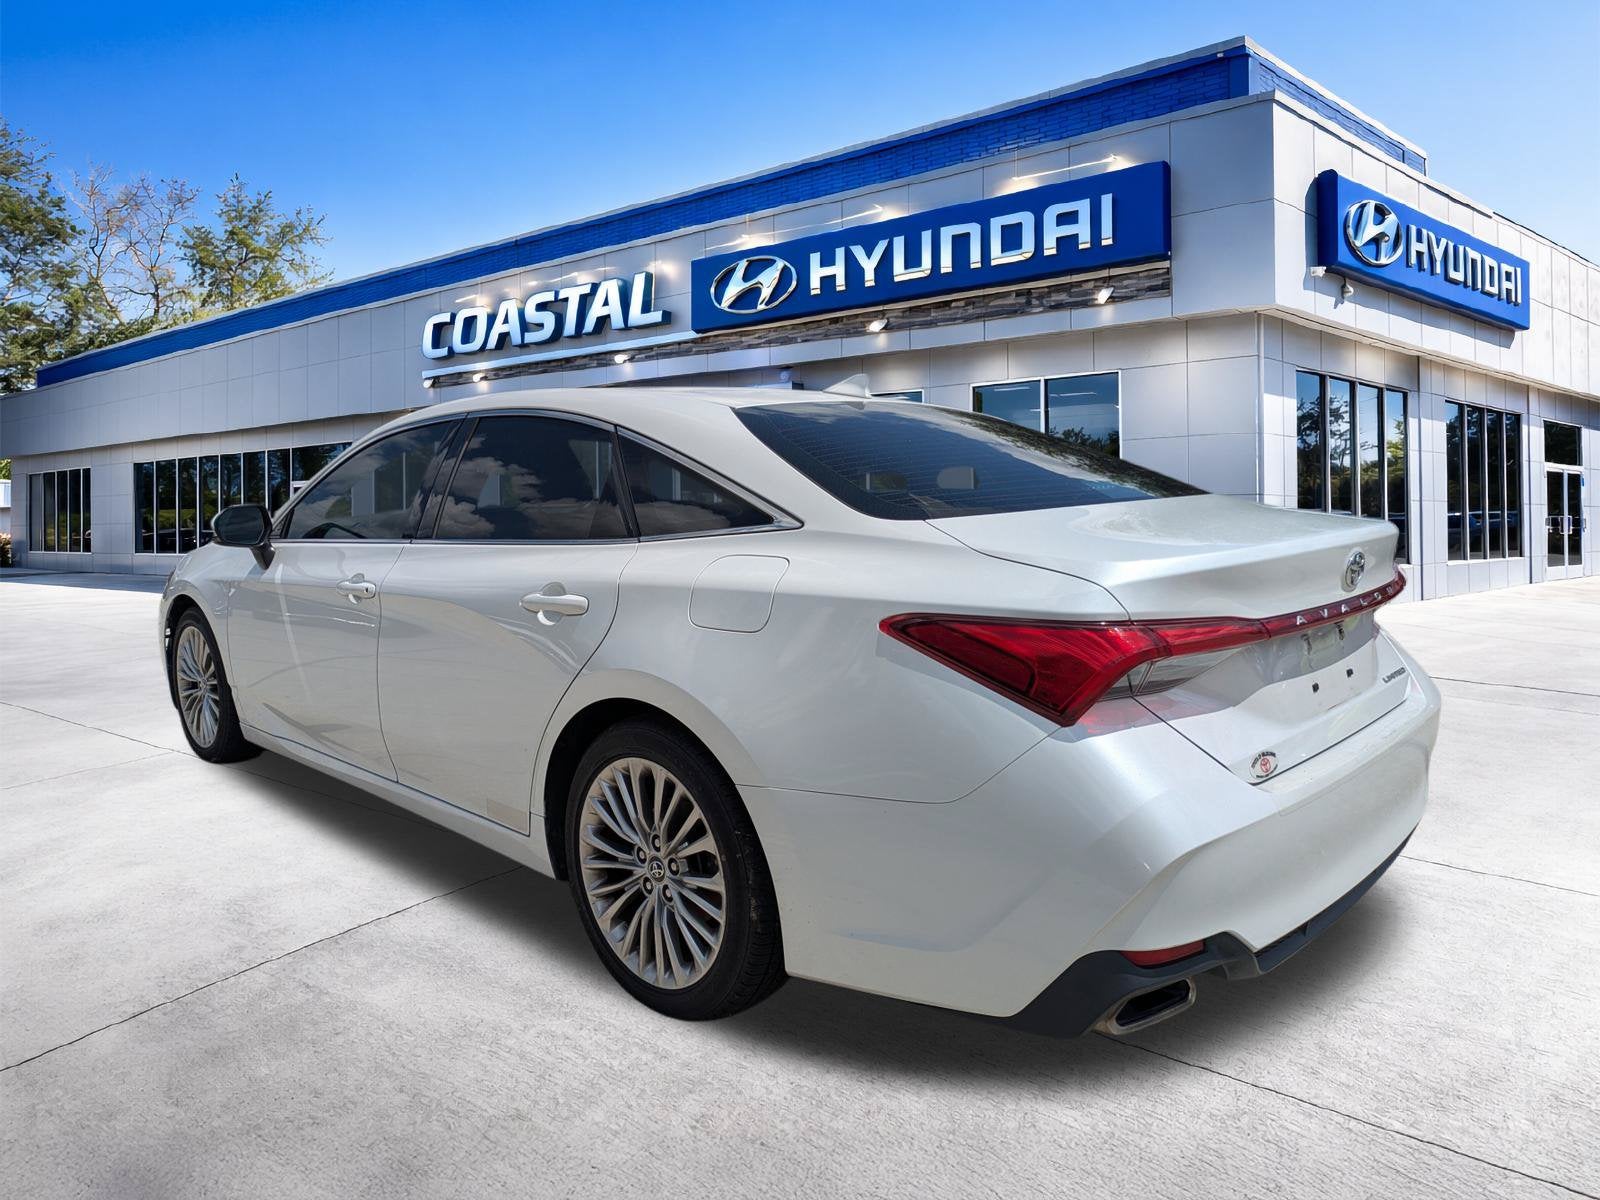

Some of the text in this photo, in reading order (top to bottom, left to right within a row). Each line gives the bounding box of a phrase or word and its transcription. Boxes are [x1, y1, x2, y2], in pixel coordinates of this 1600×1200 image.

[807, 193, 1114, 296] HYUNDAI
[1406, 224, 1522, 306] HYUNDAI
[421, 271, 669, 360] COASTAL
